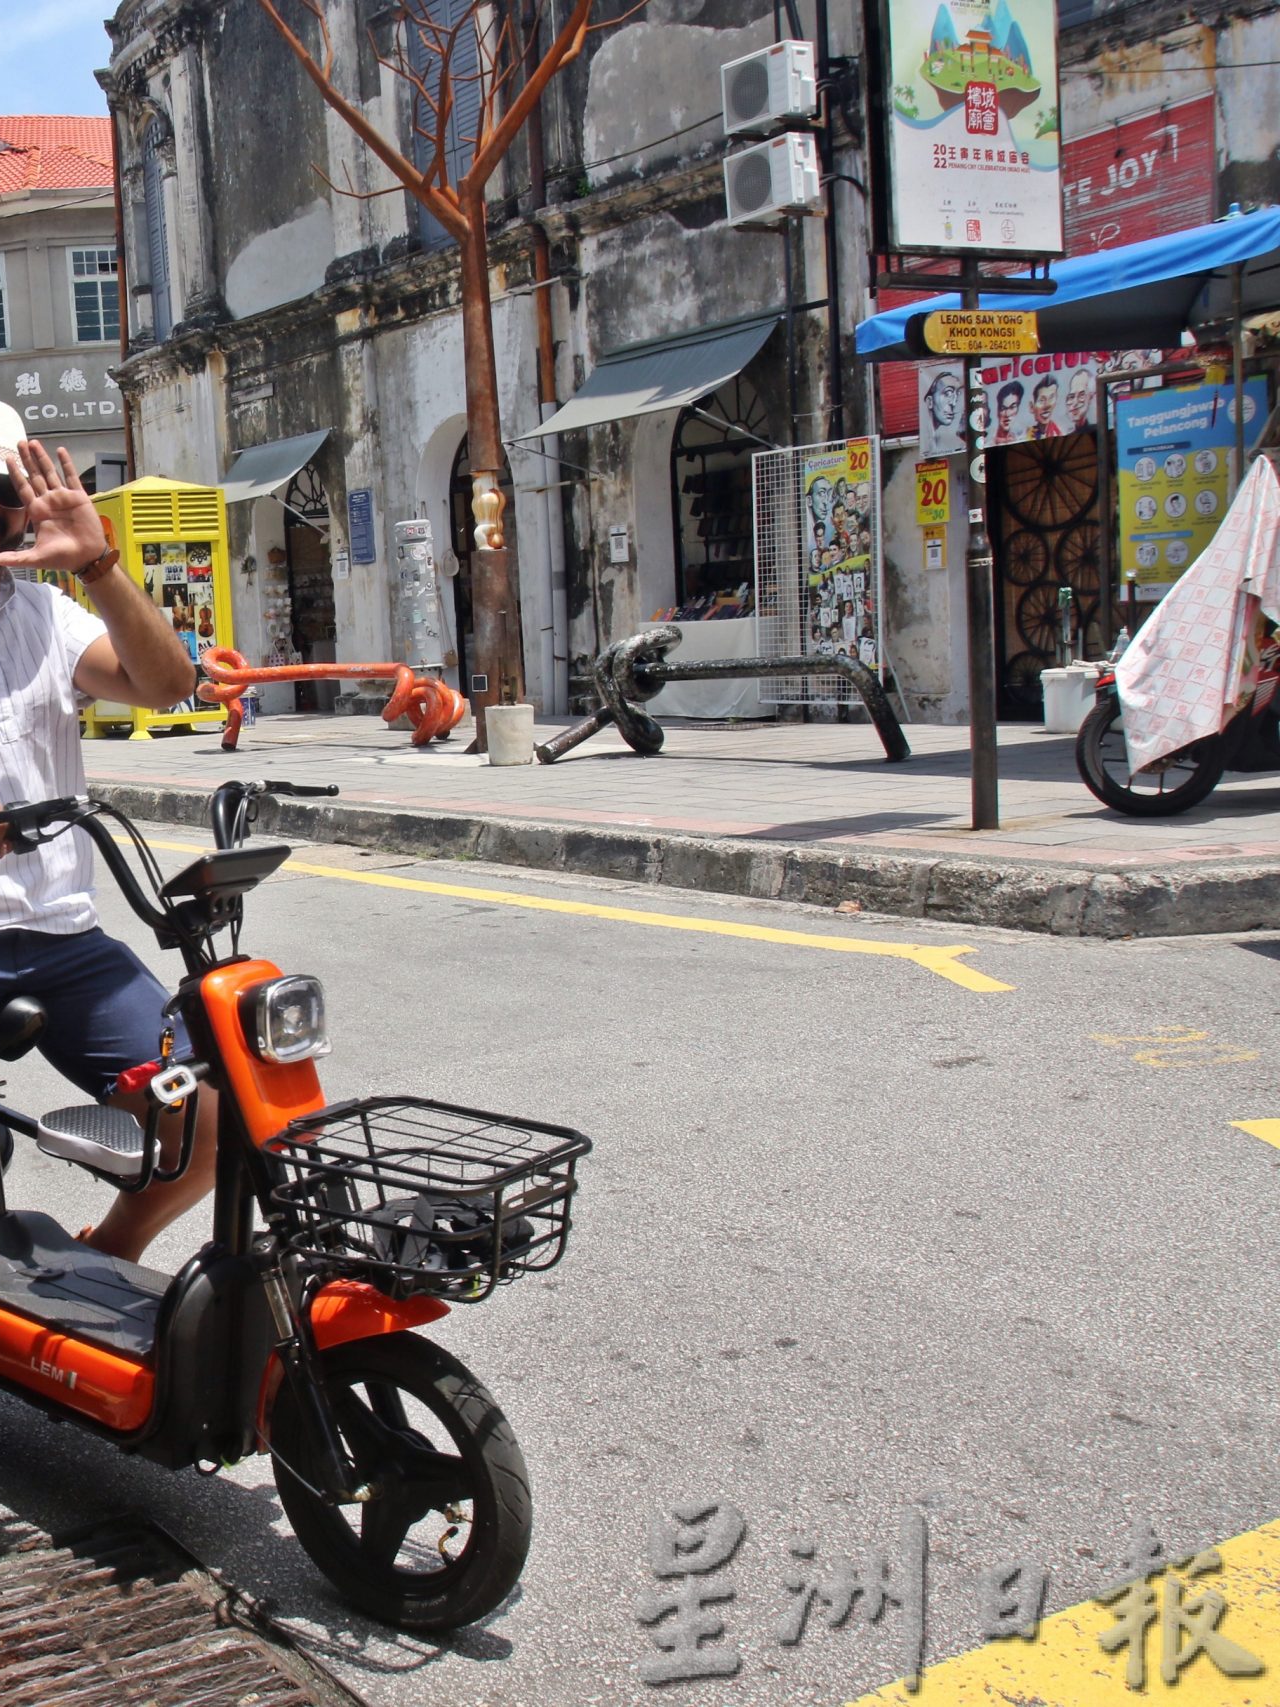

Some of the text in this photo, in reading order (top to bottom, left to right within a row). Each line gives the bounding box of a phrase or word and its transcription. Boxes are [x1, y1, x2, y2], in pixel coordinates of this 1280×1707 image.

[933, 144, 947, 155] 20
[933, 157, 947, 168] 22
[1100, 149, 1158, 196] JOY
[940, 315, 973, 325] LEONG
[975, 315, 994, 324] SAN
[949, 328, 1016, 337] KHOO KONGSI
[968, 340, 982, 350] 604
[989, 340, 1021, 350] 2642119
[975, 351, 1110, 385] aricatur
[1144, 417, 1208, 438] Pelancong
[849, 451, 869, 471] 20
[921, 479, 946, 506] 20
[30, 1356, 64, 1383] LEM
